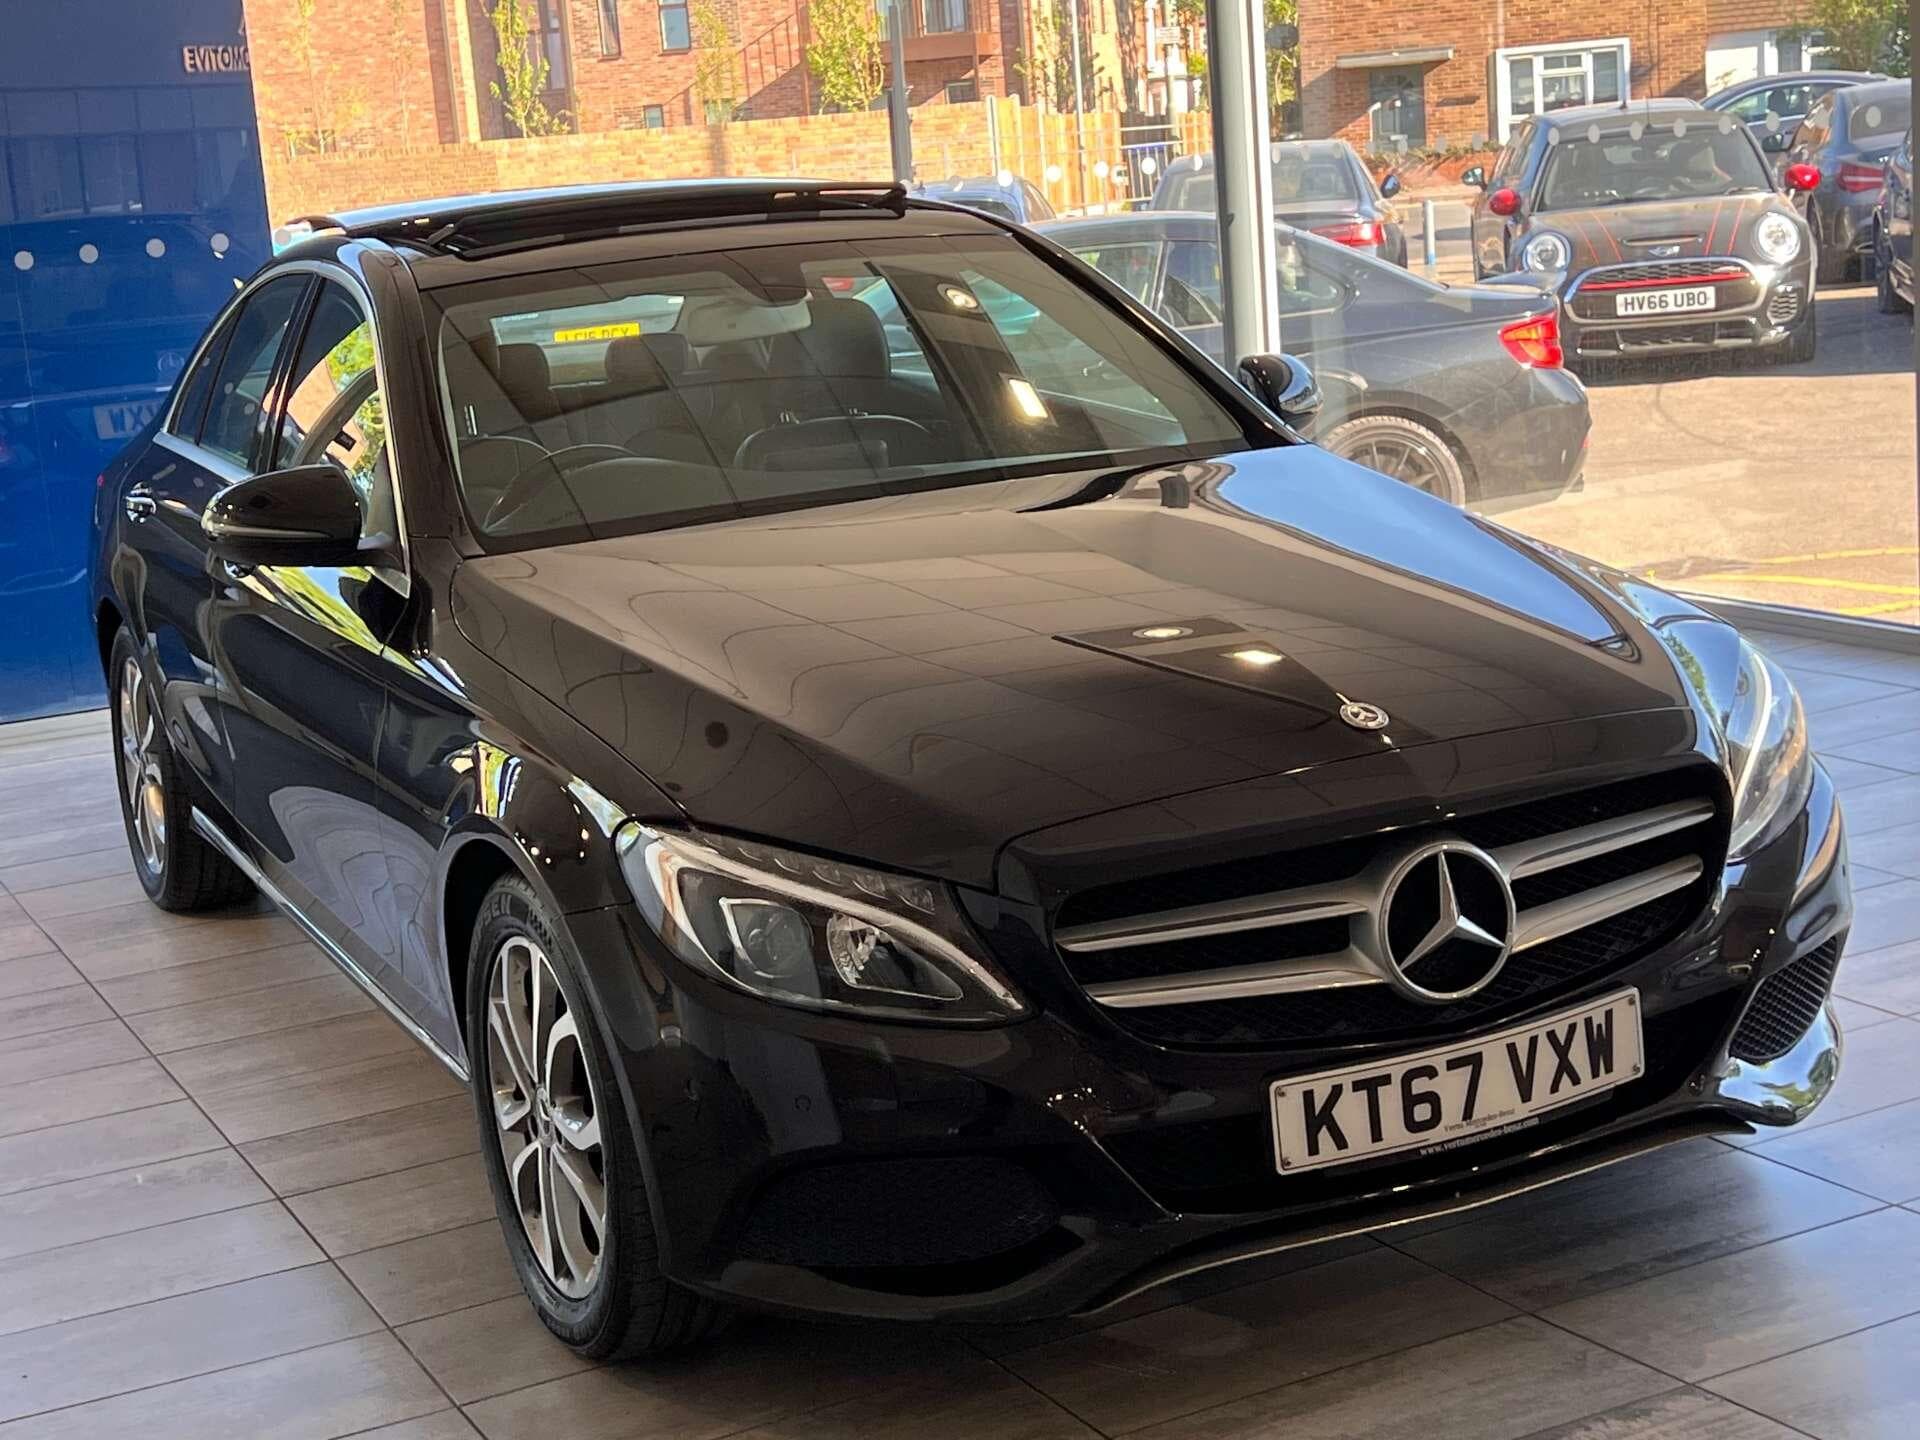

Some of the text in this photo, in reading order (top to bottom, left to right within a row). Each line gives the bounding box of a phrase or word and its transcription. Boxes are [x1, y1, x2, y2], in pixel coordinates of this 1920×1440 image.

[1624, 291, 1708, 312] HV66 UBO
[1302, 1008, 1615, 1158] KT67 VXW
